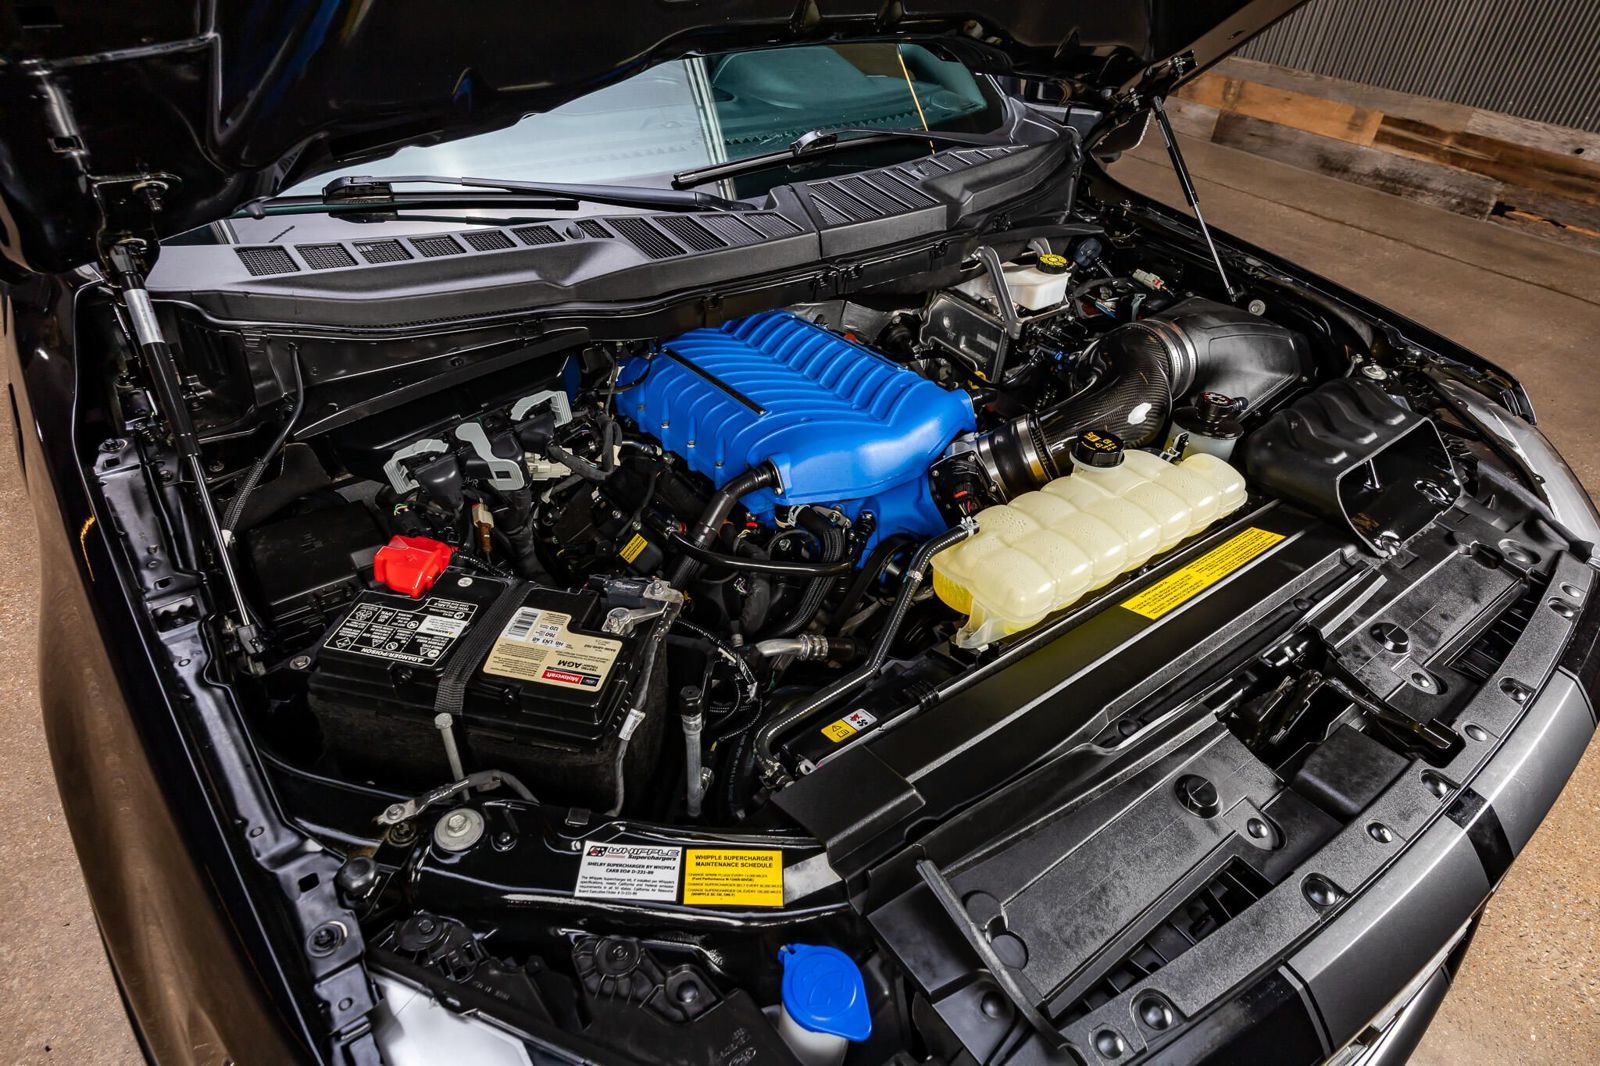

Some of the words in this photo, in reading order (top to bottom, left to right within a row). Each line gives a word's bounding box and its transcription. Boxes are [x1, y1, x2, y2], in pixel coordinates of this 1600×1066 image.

[558, 660, 582, 669] AGM
[546, 672, 580, 683] Motorcraft
[607, 847, 680, 857] WHIPPLE
[628, 854, 676, 862] Superchargers
